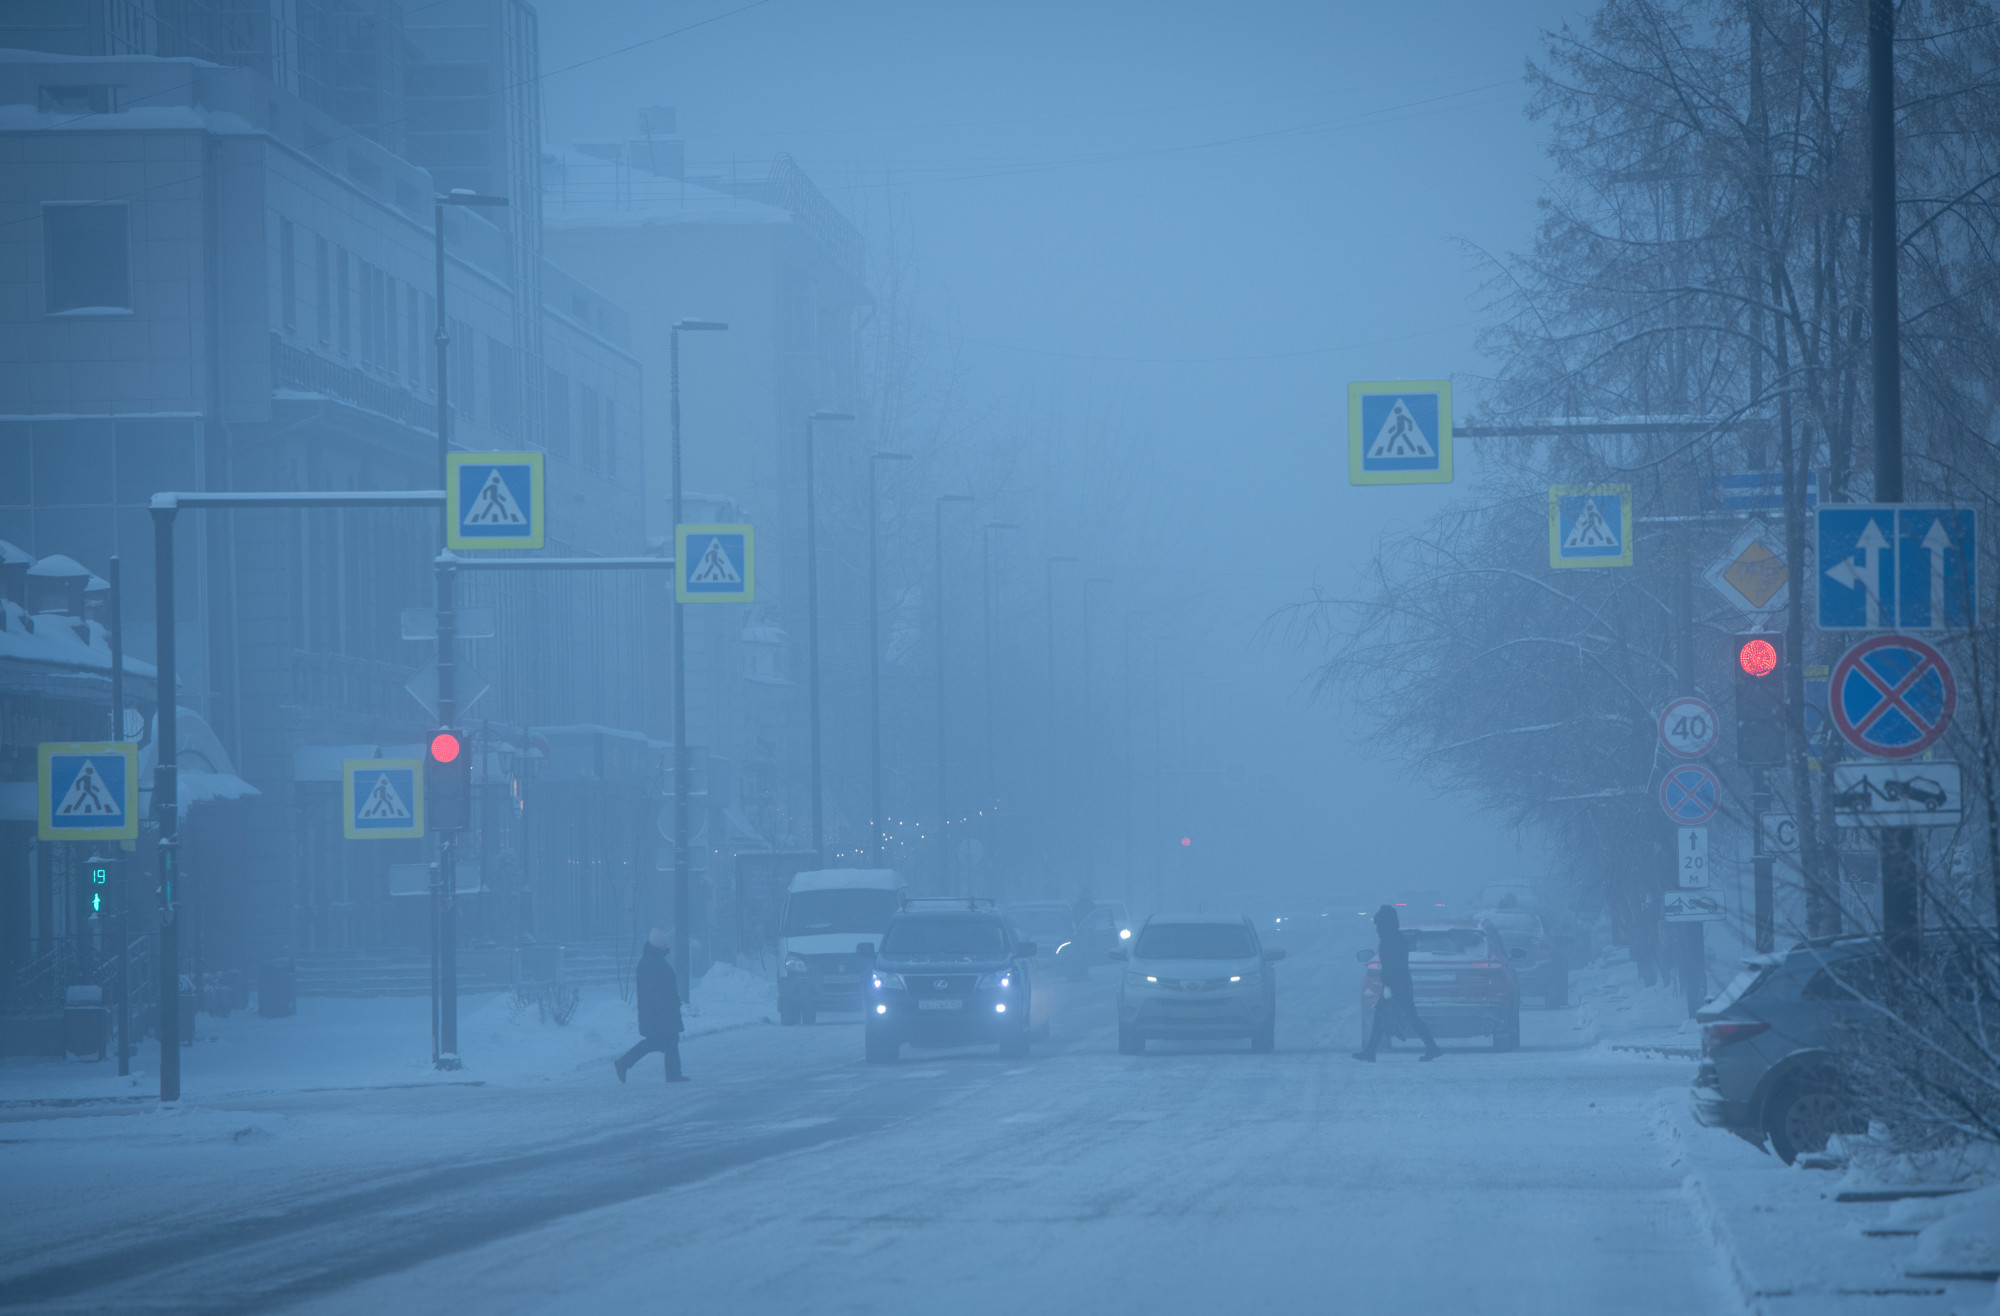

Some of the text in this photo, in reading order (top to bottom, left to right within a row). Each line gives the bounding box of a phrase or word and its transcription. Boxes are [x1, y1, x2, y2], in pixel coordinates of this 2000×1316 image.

[1672, 716, 1707, 740] 40
[1684, 857, 1704, 869] 20
[93, 869, 106, 884] 19
